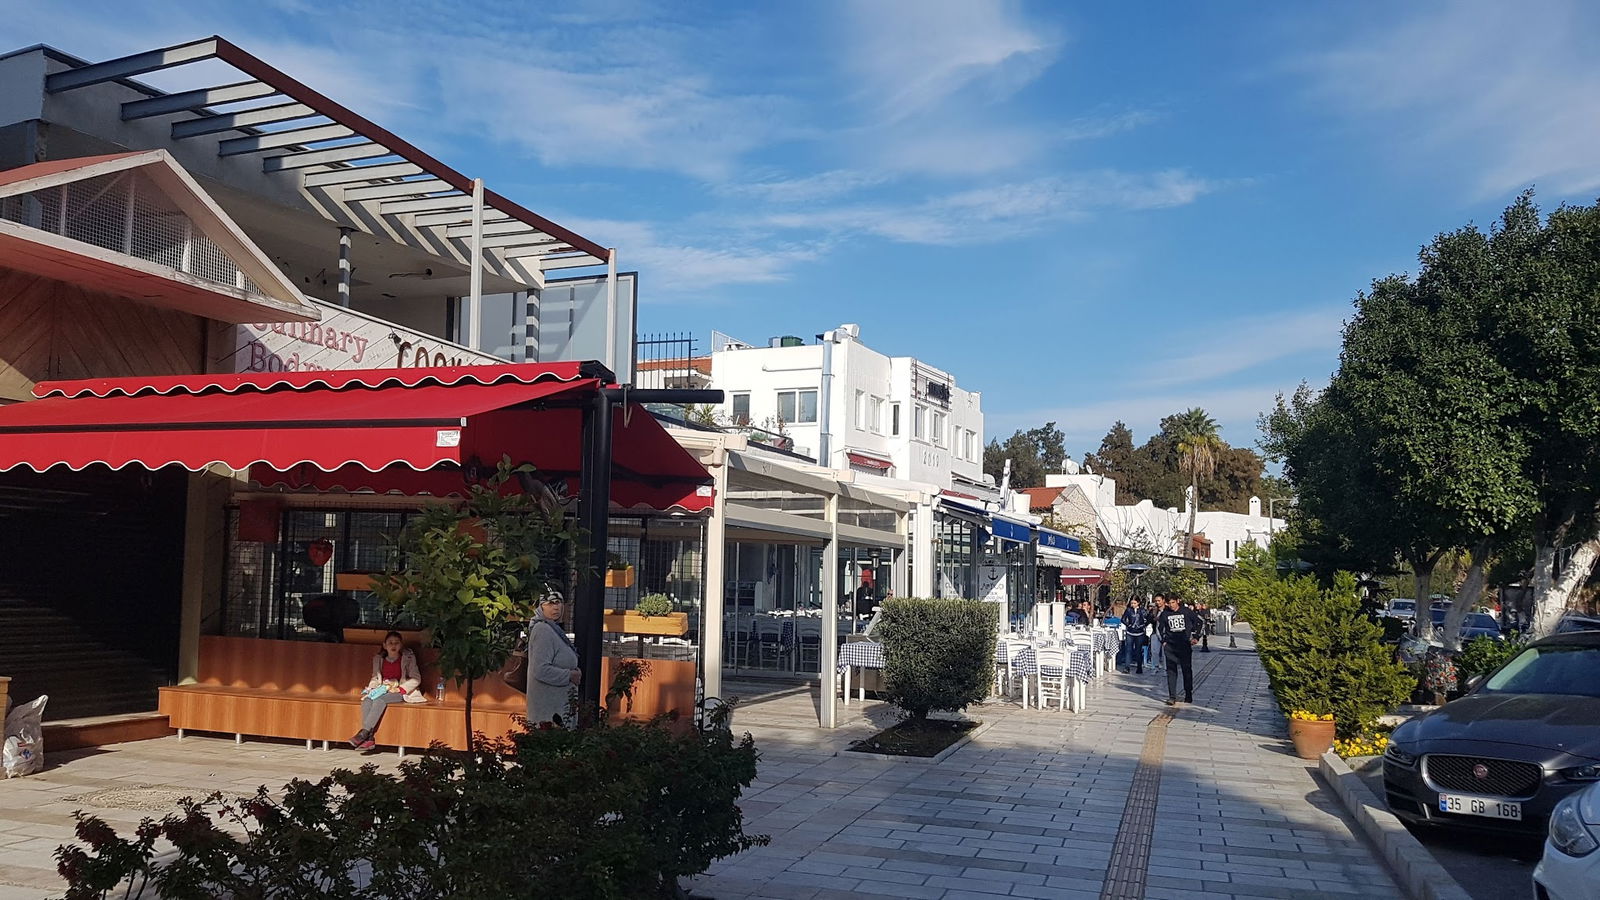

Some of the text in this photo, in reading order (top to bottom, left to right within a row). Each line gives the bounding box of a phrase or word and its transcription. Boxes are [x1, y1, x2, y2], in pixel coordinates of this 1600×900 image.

[1168, 618, 1186, 629] 089
[1447, 797, 1518, 818] 35 GB 168
